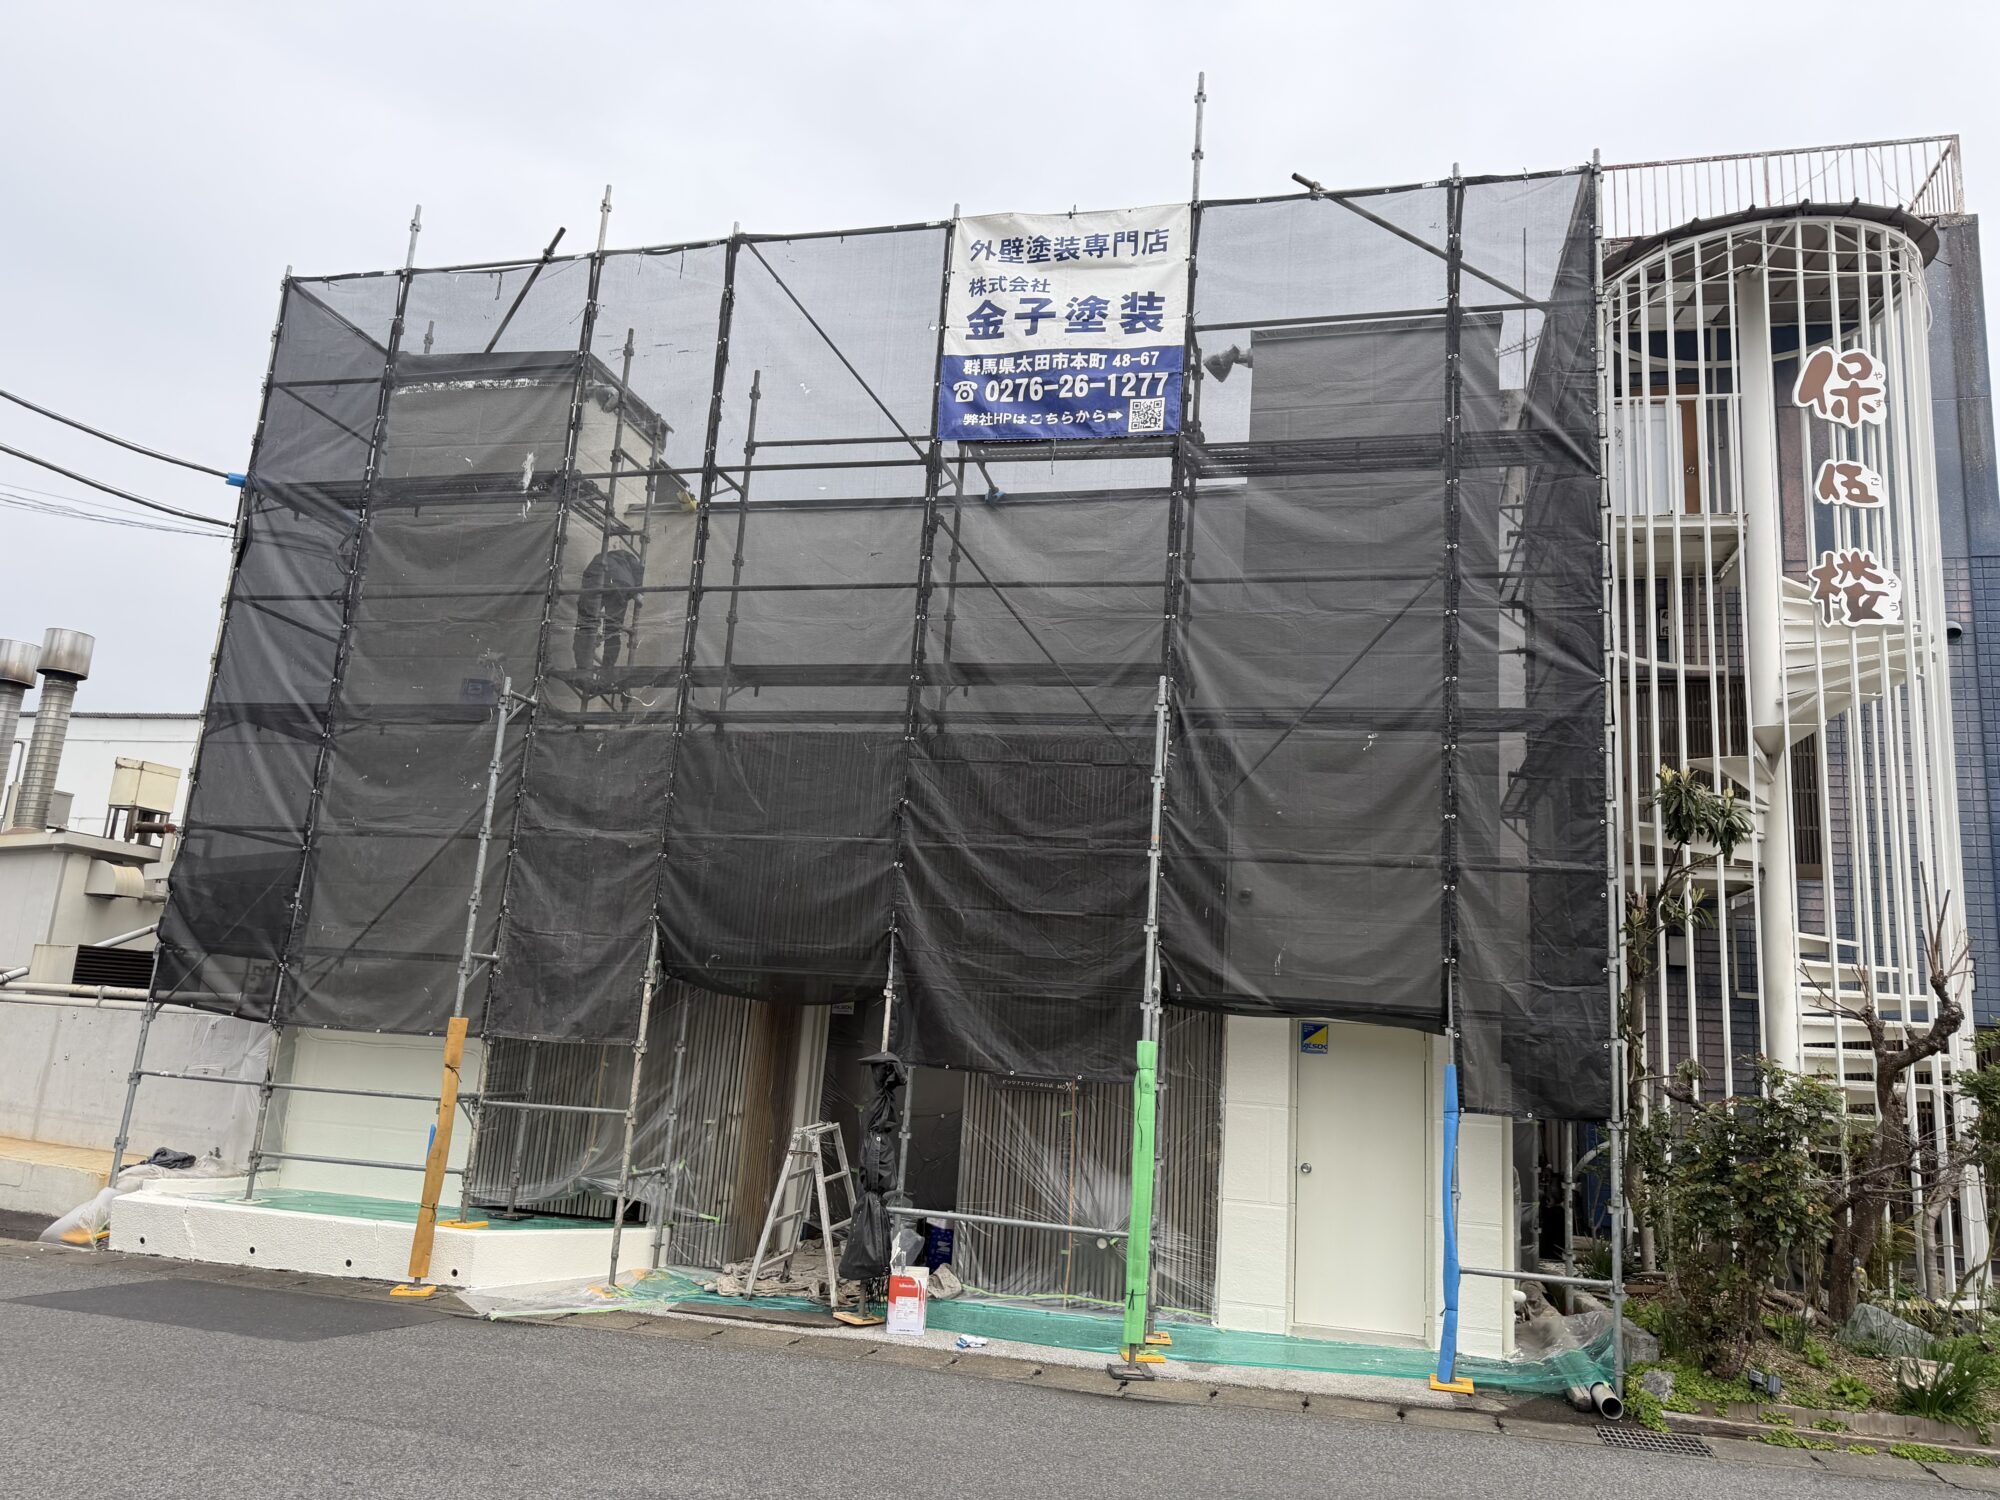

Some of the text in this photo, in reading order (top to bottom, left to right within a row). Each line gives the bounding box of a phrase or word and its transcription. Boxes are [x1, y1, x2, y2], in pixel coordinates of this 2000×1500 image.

[970, 228, 1169, 264] 外壁塗装専門店
[968, 275, 1051, 297] 株式会社
[965, 291, 1165, 341] 金子塗装
[962, 351, 1160, 376] 群馬県太田市本町 48-67
[984, 372, 1169, 403] 0276-26-1277
[962, 409, 1107, 426] 弊社HPはこちらから
